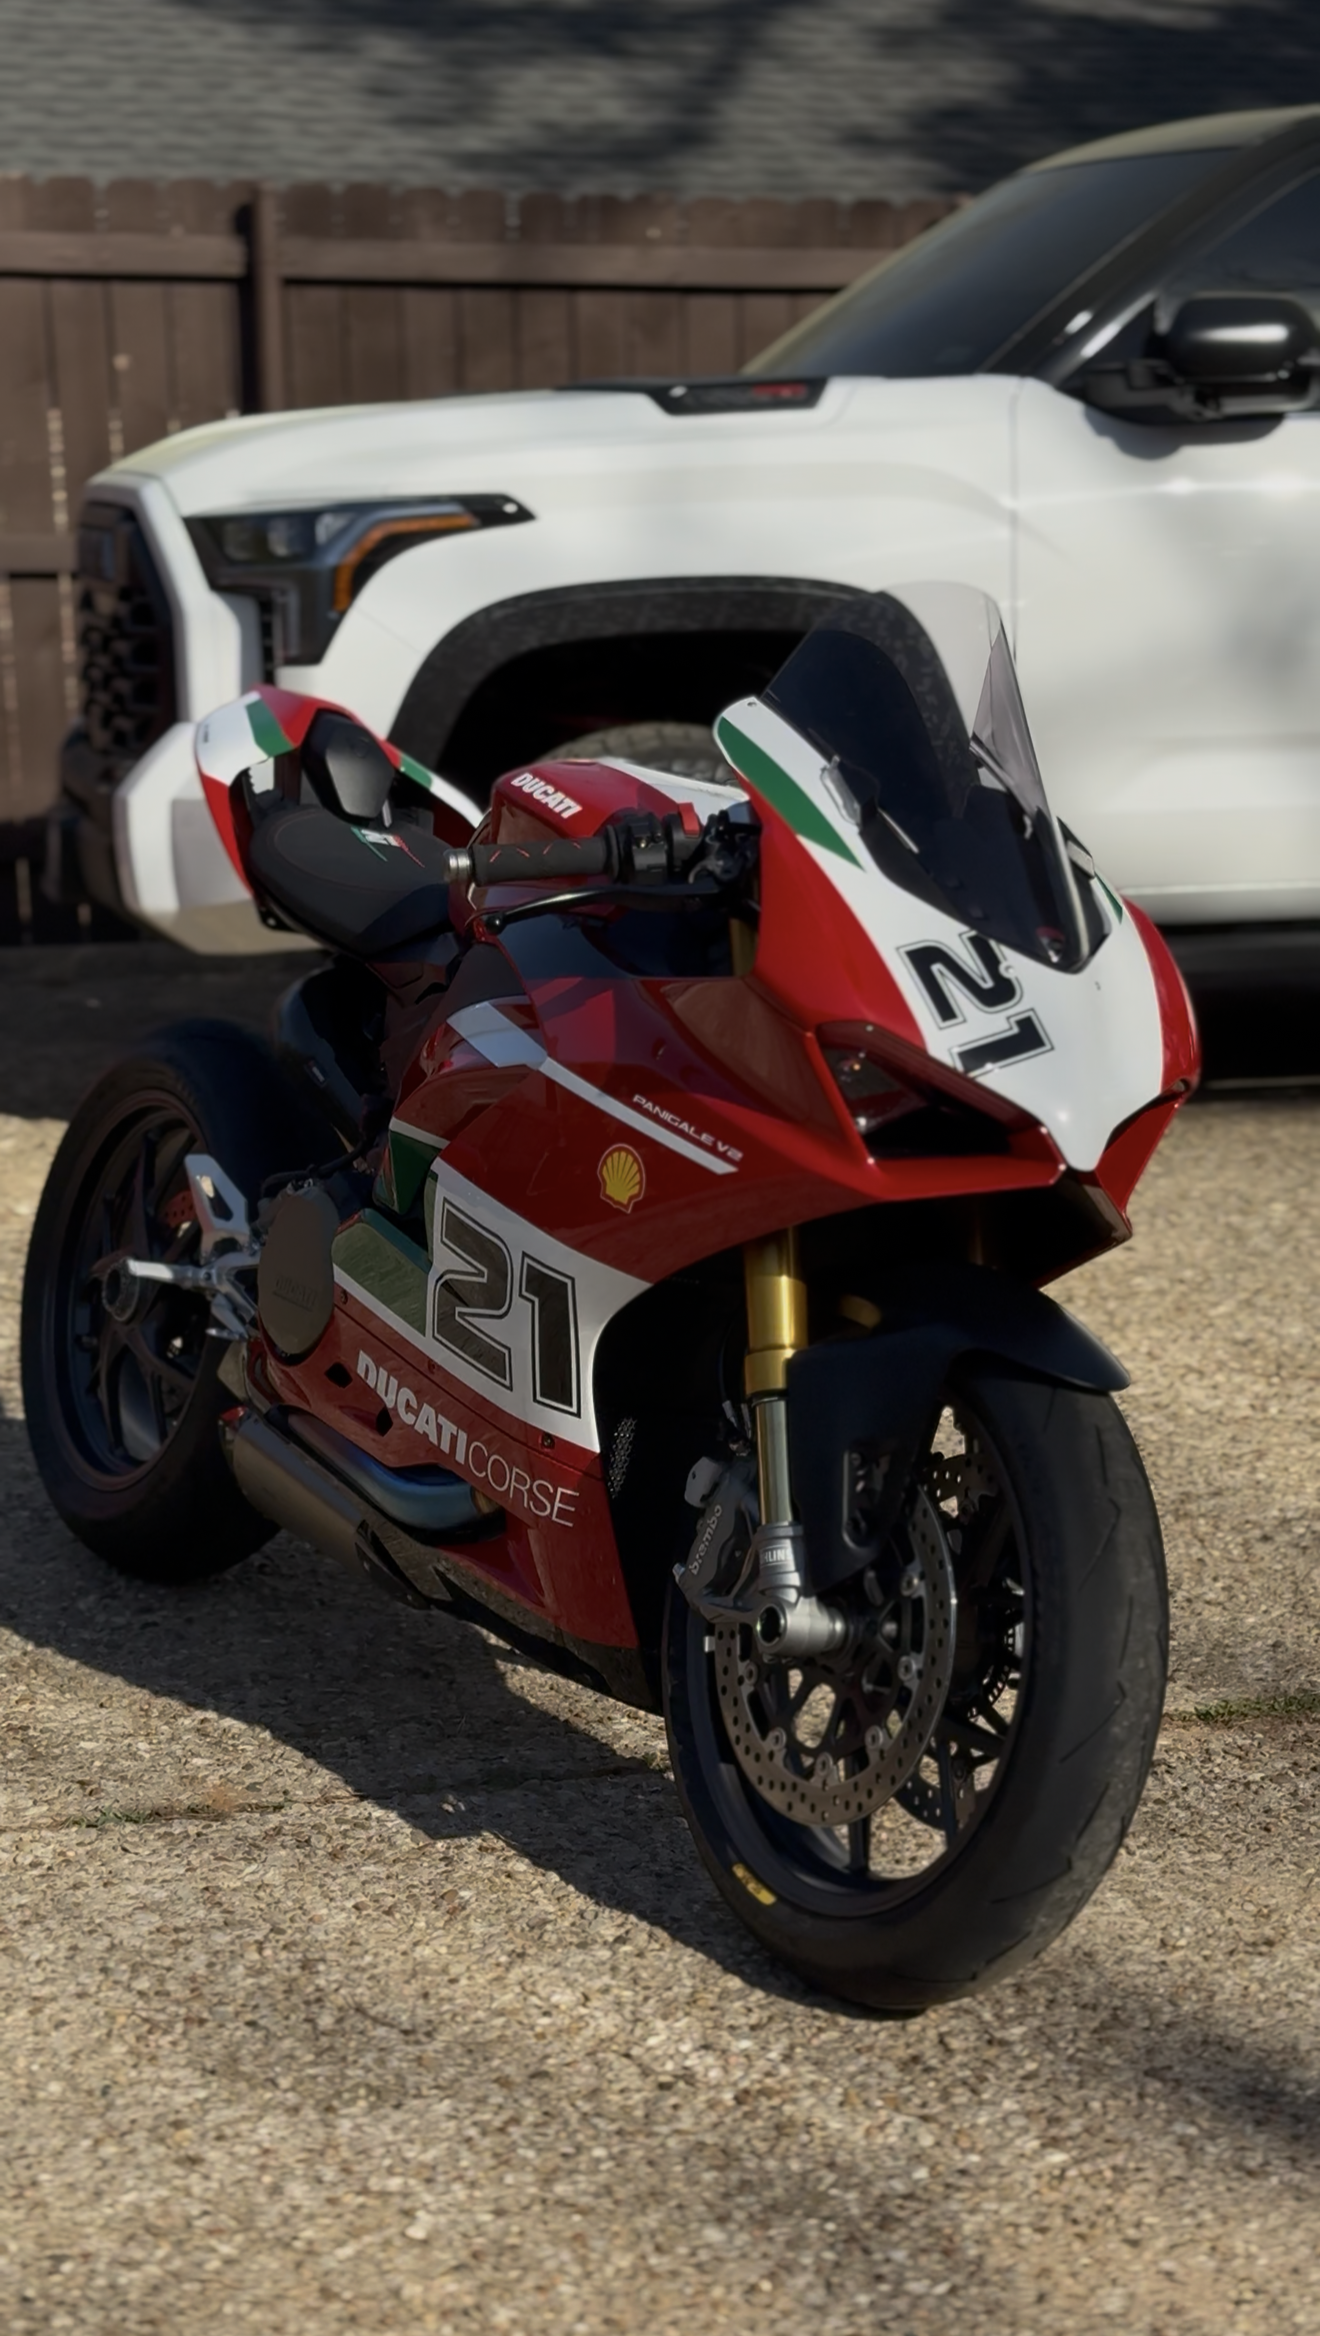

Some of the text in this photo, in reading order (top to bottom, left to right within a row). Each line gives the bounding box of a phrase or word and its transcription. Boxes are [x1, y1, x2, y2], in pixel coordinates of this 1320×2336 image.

[510, 772, 583, 819] DUCATI
[896, 929, 1054, 1080] 21
[632, 1093, 744, 1163] PANIGALE V2
[432, 1197, 581, 1418] 21
[356, 1350, 580, 1528] DUCATI CORSE
[689, 1504, 722, 1575] brembo
